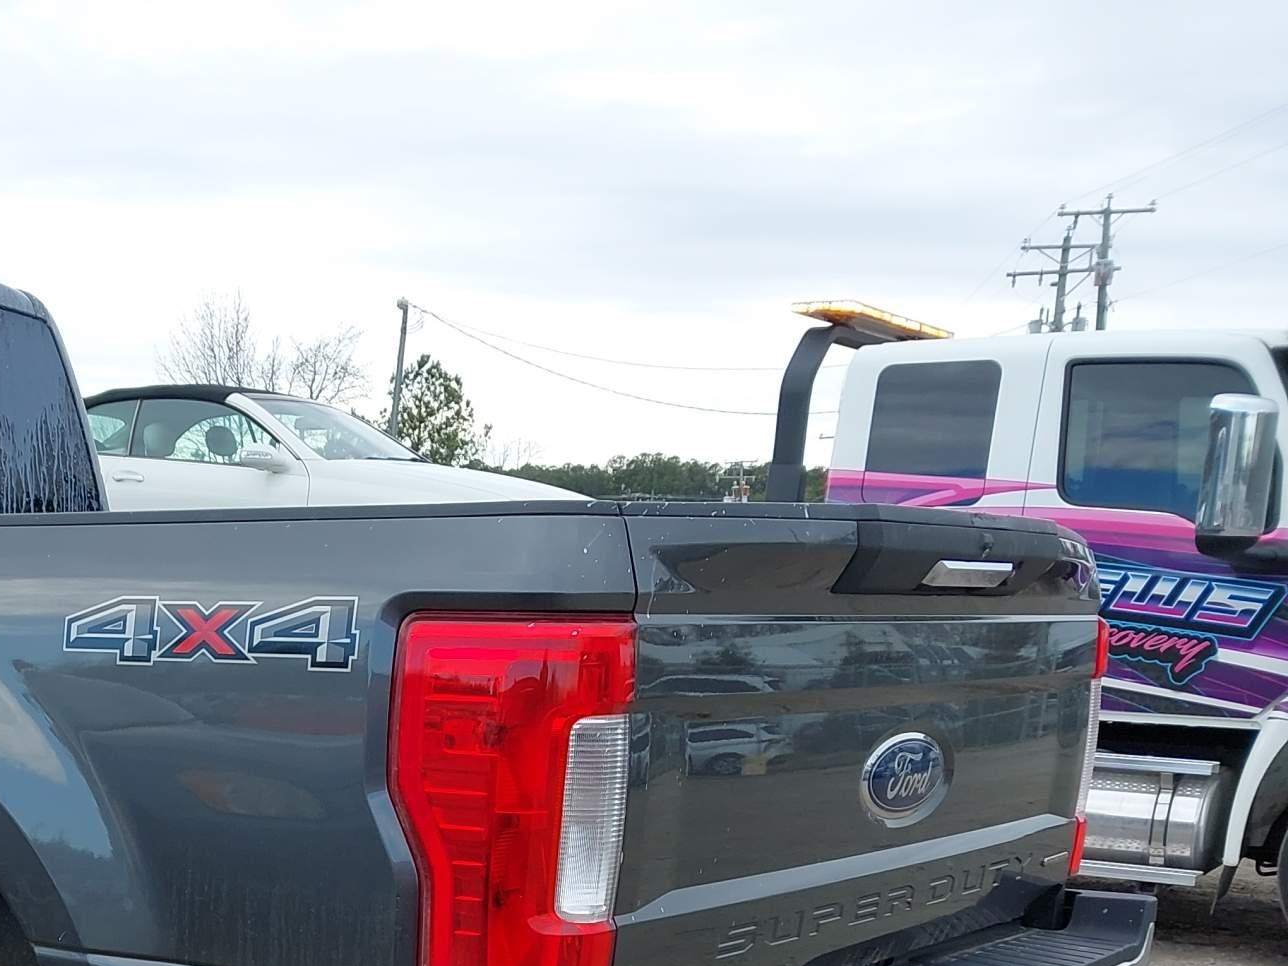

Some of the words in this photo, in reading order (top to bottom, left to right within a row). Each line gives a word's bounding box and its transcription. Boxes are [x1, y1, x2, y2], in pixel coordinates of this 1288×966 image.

[886, 752, 933, 800] Ford
[715, 884, 915, 960] SUPER
[925, 852, 1033, 906] DUTY
